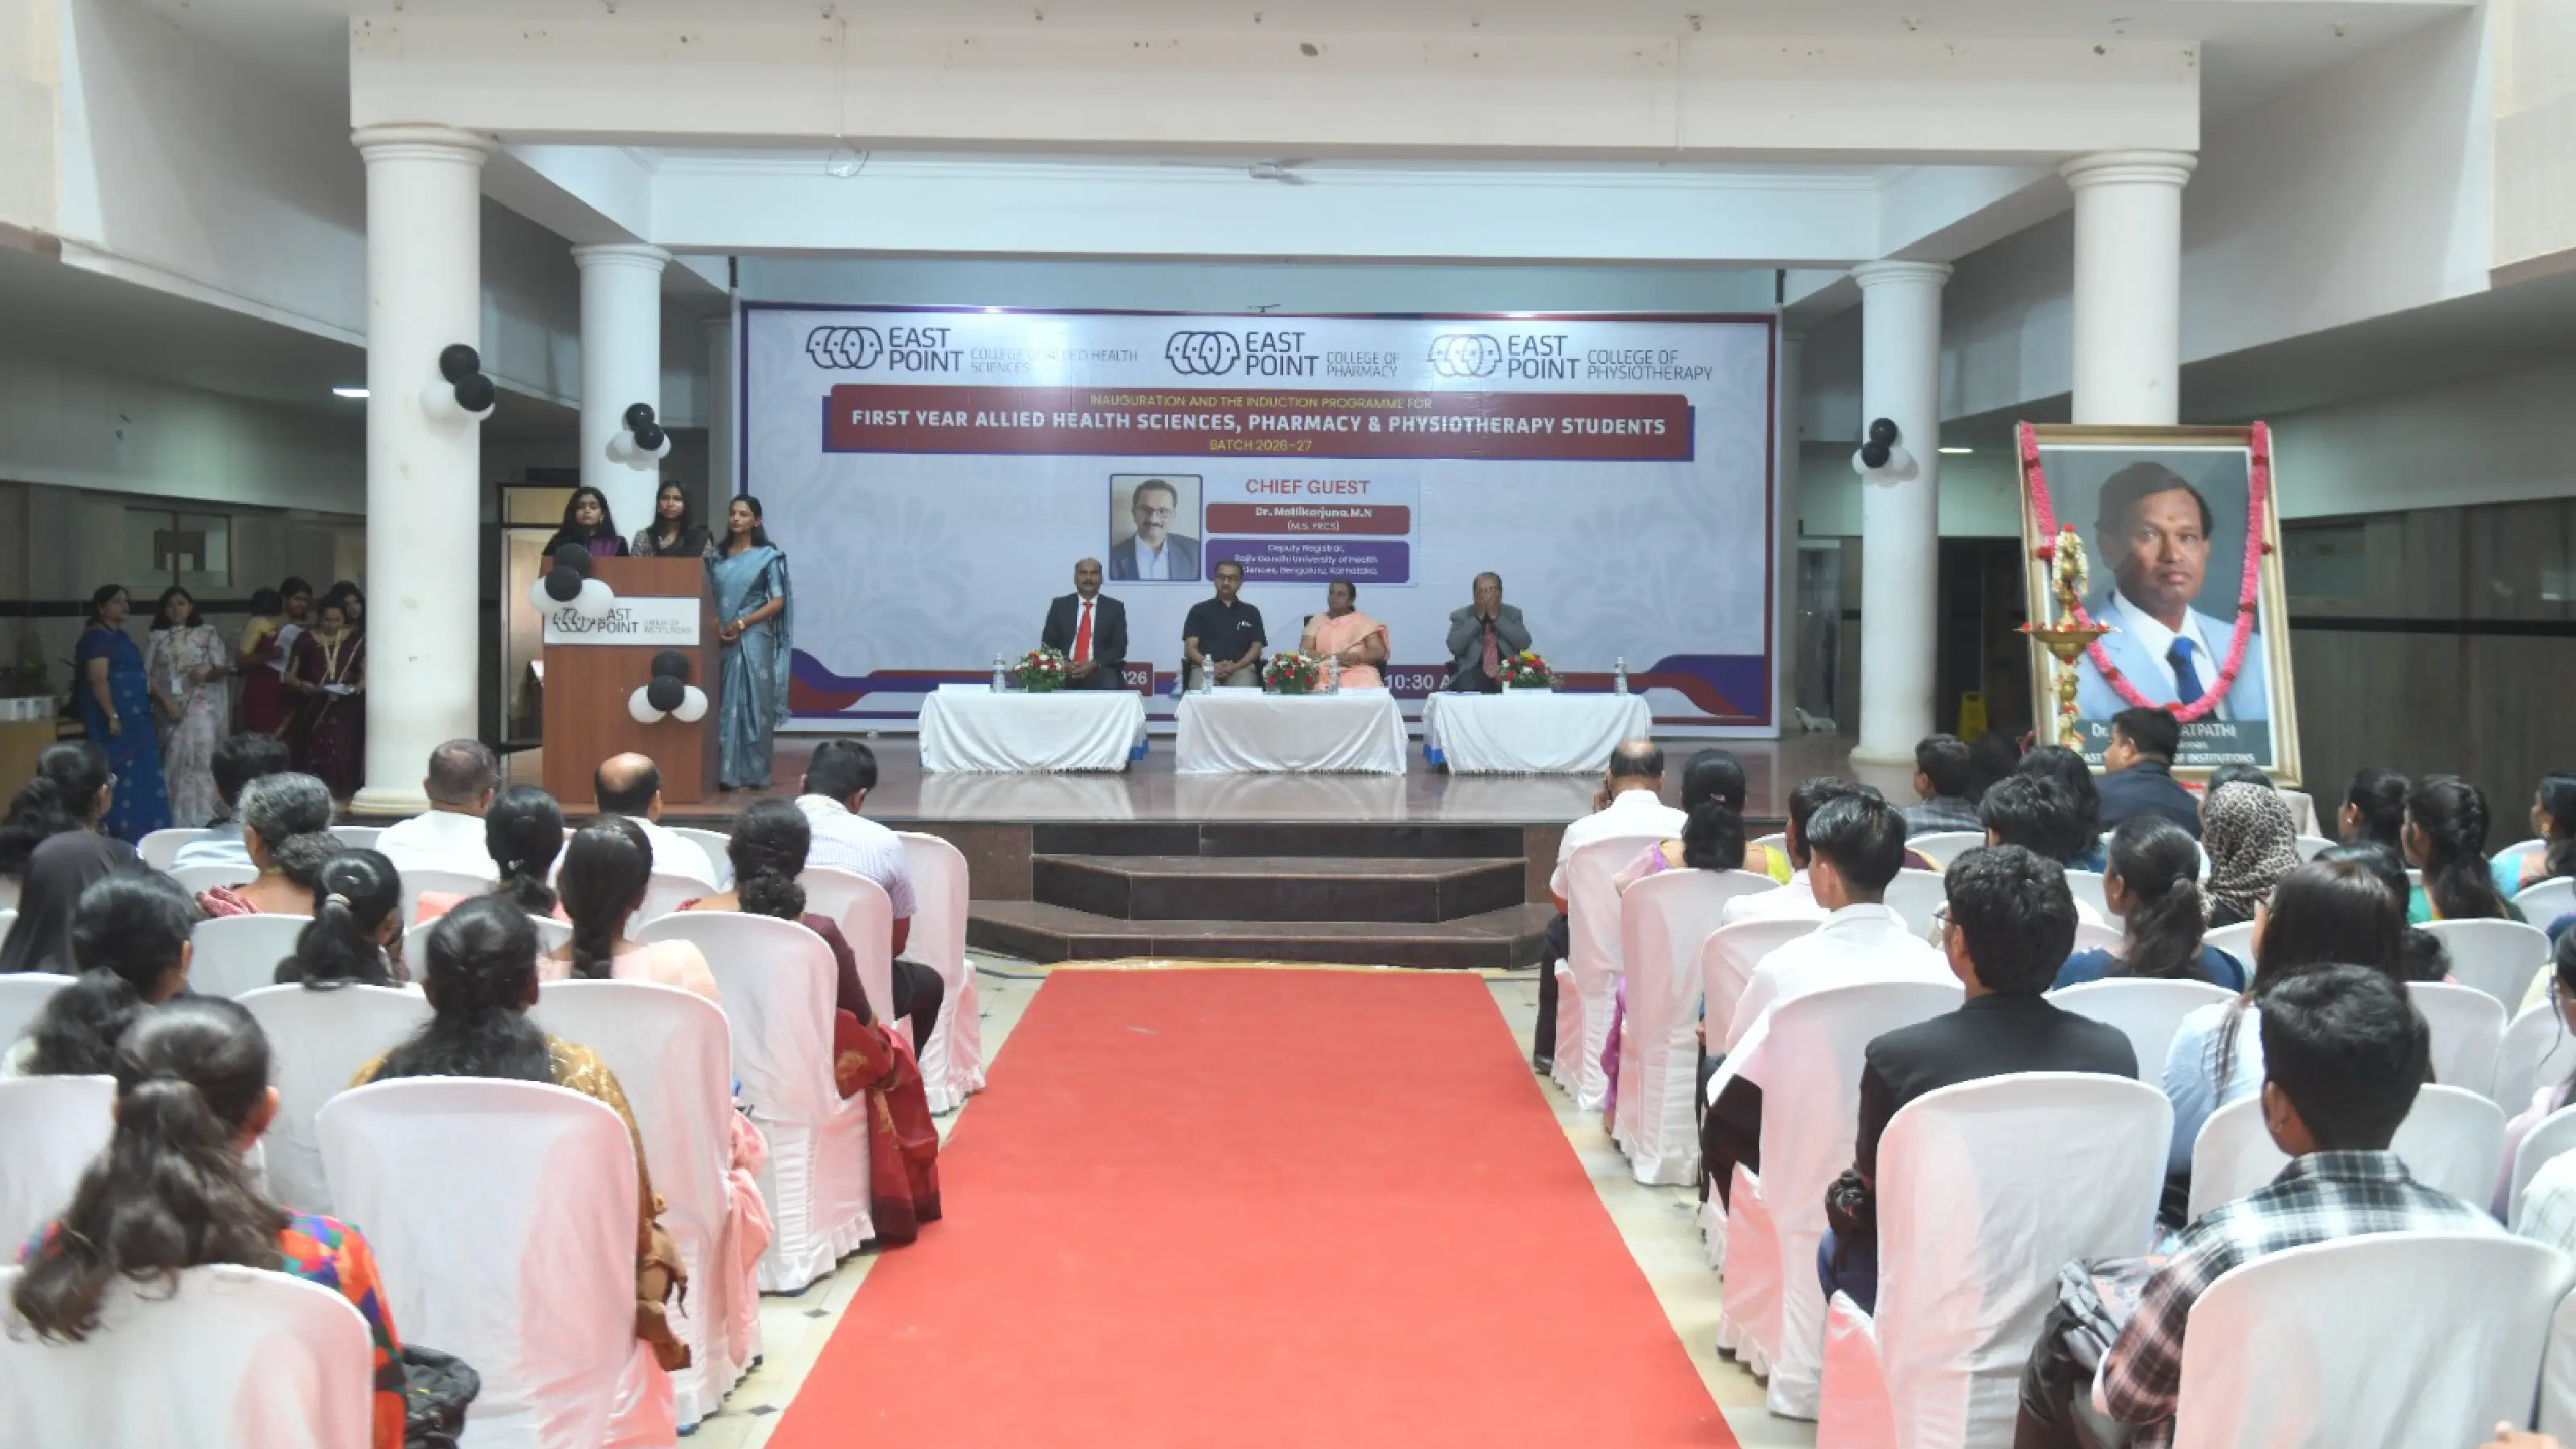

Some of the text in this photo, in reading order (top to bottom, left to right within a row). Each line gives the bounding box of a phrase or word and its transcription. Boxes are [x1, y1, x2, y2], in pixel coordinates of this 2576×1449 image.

[889, 327, 951, 348] EAST
[1245, 332, 1306, 353] EAST
[1508, 335, 1569, 357] EAST
[889, 349, 964, 372] POINT
[971, 347, 1024, 361] COLLEGE
[1092, 349, 1138, 362] HEALTH
[1327, 351, 1400, 364] COLLEGE OF
[1587, 349, 1679, 365] COLLEGE OF
[971, 361, 1030, 373] SCIENCES
[1245, 355, 1320, 377] POINT
[1327, 365, 1397, 378] PHARMACY
[1508, 358, 1581, 380] POINT
[1587, 365, 1713, 381] PHYSIOTHERAPY
[1090, 394, 1432, 410] INAUGURATION AND THE INDUCTION PROGRAMME FOR
[852, 409, 1666, 436] FIRST YEAR ALLIED HEALTH SCIENCES, PHARMACY & PHYSIOTHERAPY STUDENTS
[1210, 439, 1253, 451] BATCH
[1245, 478, 1371, 495] CHIEF GUEST
[1255, 506, 1273, 516] Dr.
[597, 621, 640, 634] POINT
[1383, 673, 1435, 691] 10:30
[2091, 723, 2236, 738] Dr. ATPATHI
